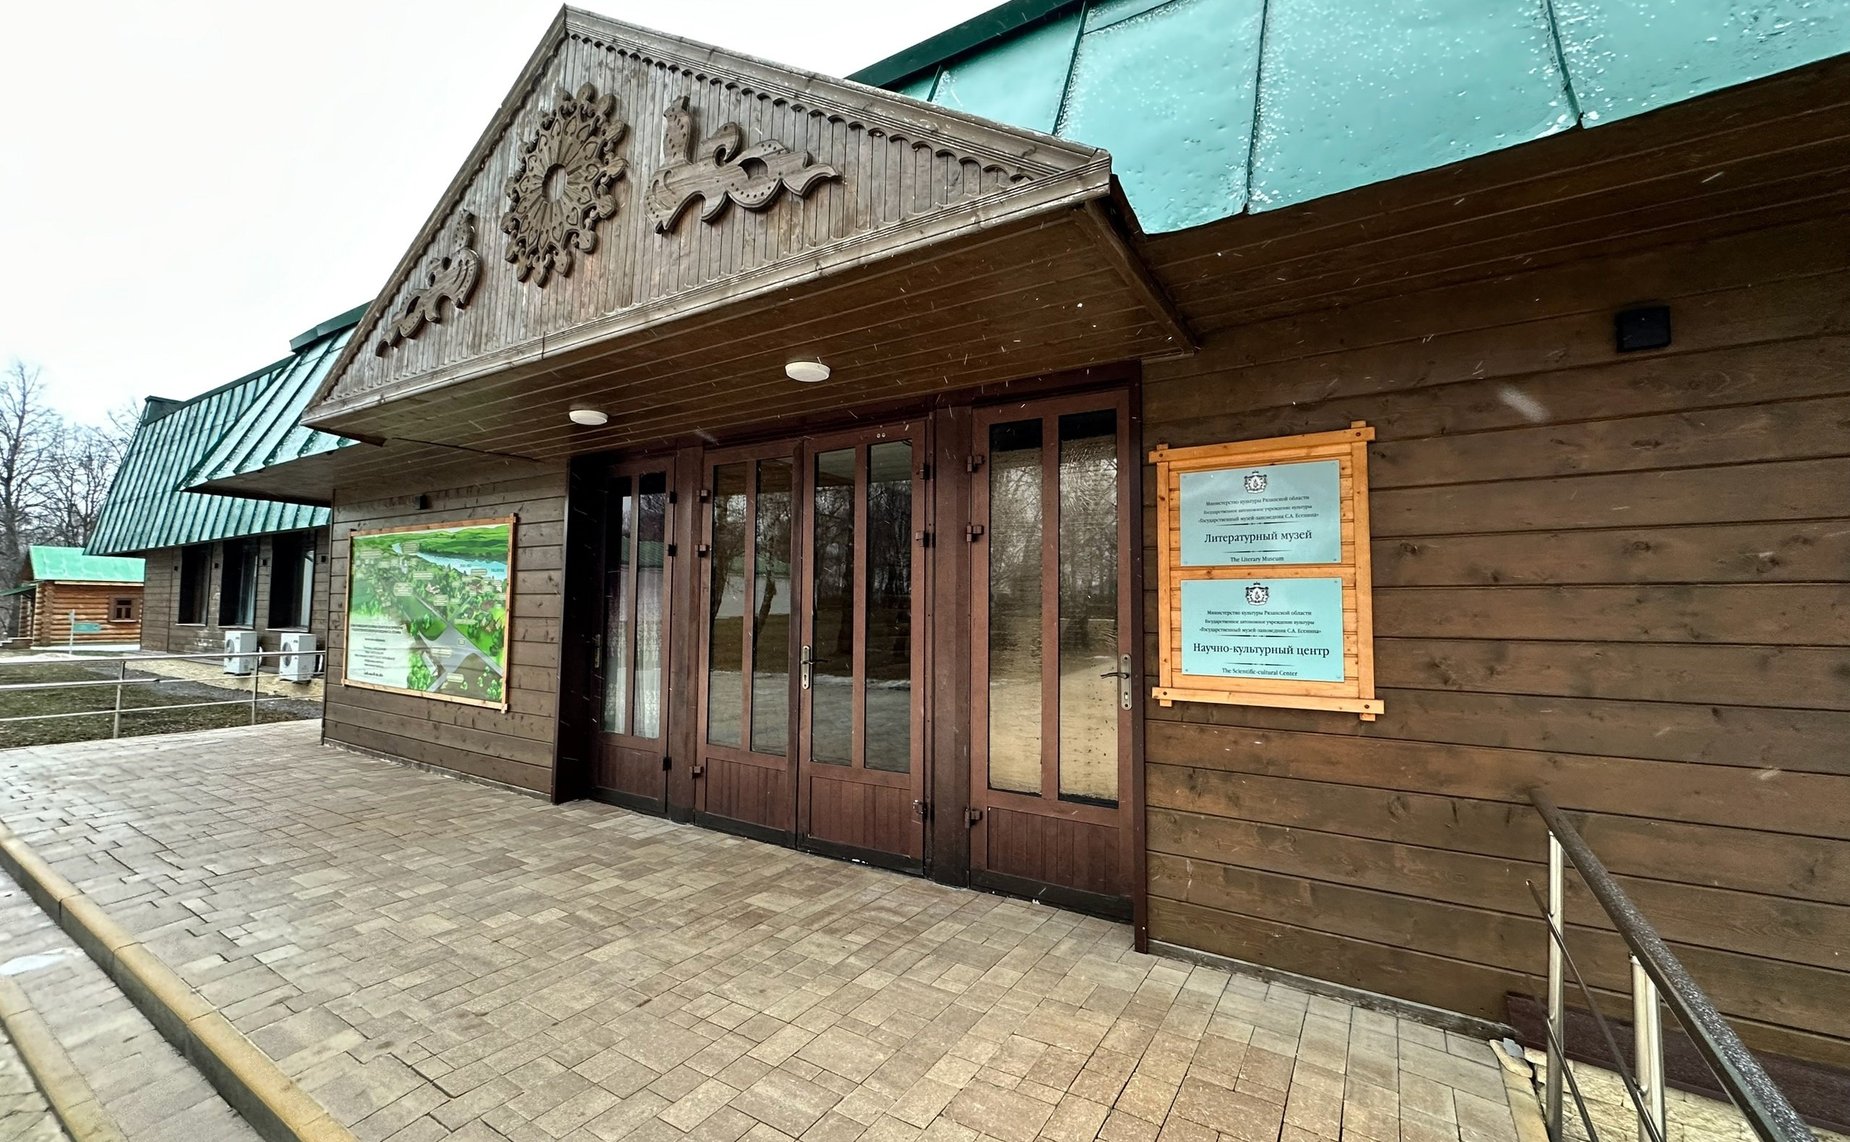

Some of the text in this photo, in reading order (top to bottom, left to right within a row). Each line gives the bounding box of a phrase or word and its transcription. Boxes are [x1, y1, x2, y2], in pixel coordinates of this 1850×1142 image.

[1204, 530, 1312, 545] Литературный музей
[1193, 643, 1330, 658] Научно-культурный центр
